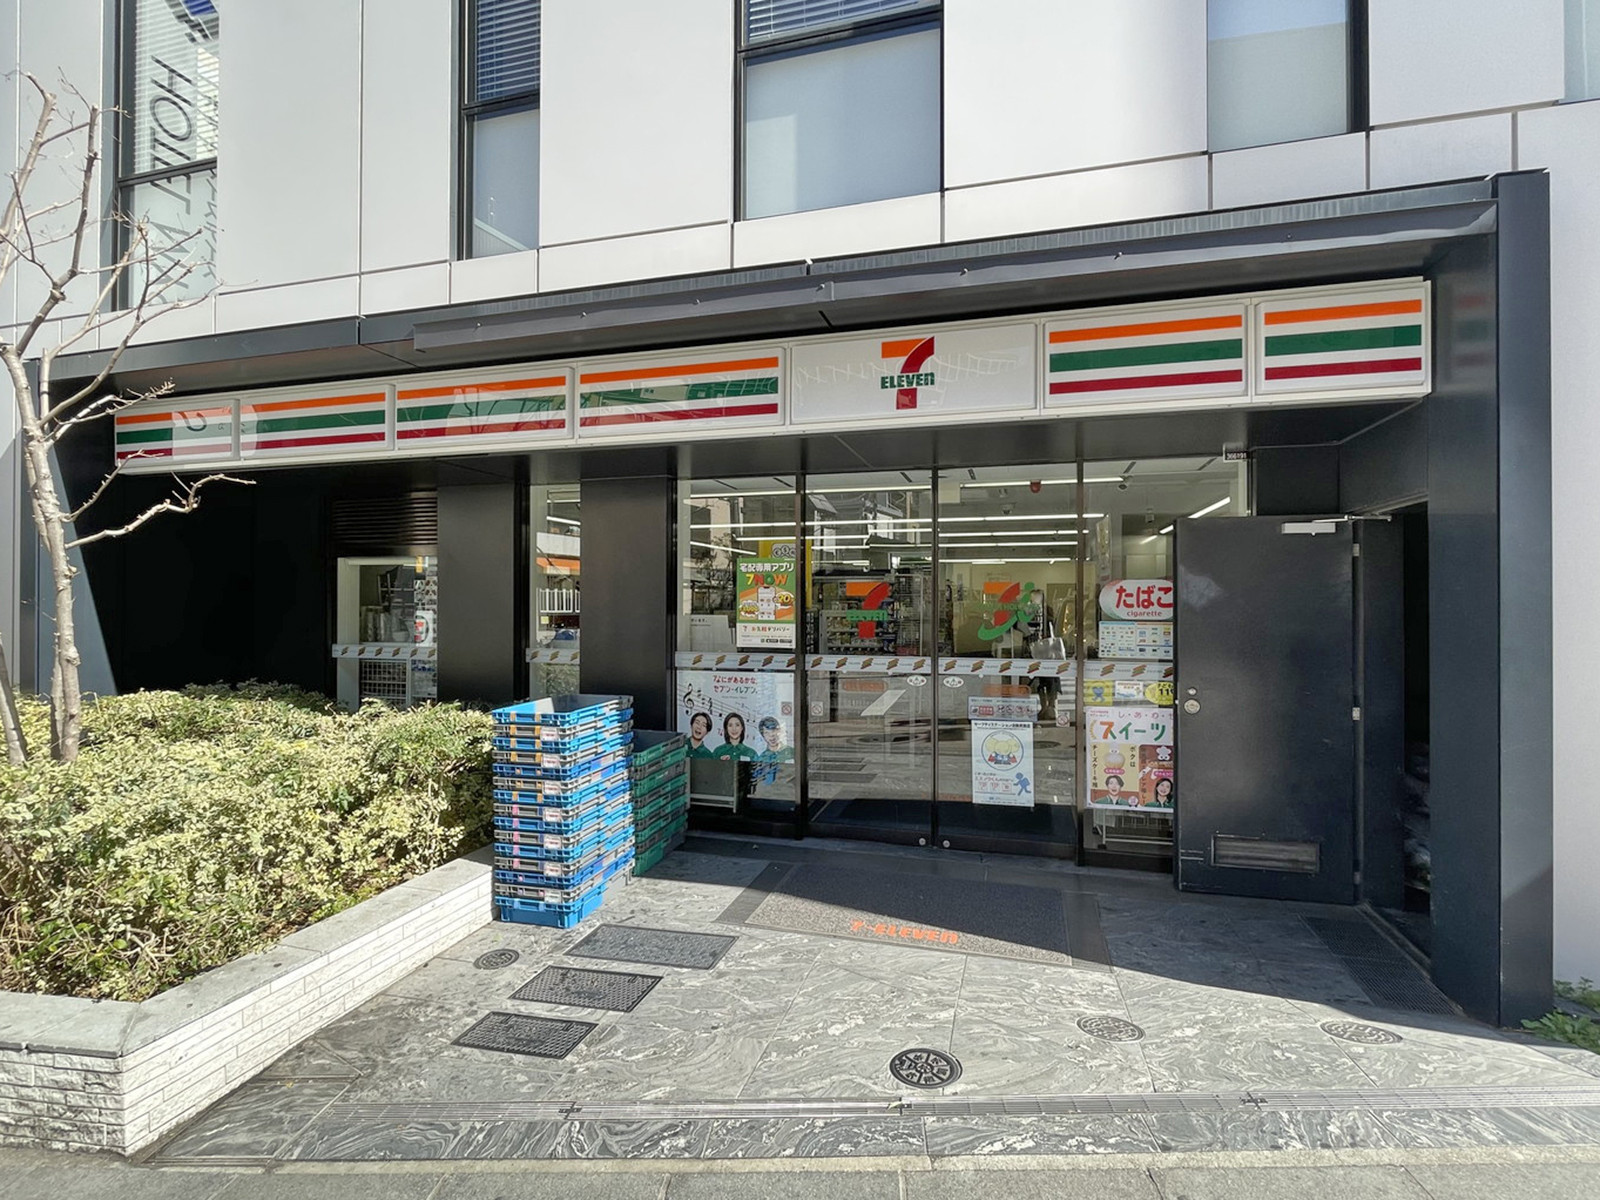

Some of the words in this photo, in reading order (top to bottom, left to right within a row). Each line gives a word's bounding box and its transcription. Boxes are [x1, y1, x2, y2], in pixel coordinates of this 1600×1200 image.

[1115, 585, 1174, 609] たばこ
[1126, 610, 1163, 618] cigarette
[1100, 720, 1166, 742] スイーツ
